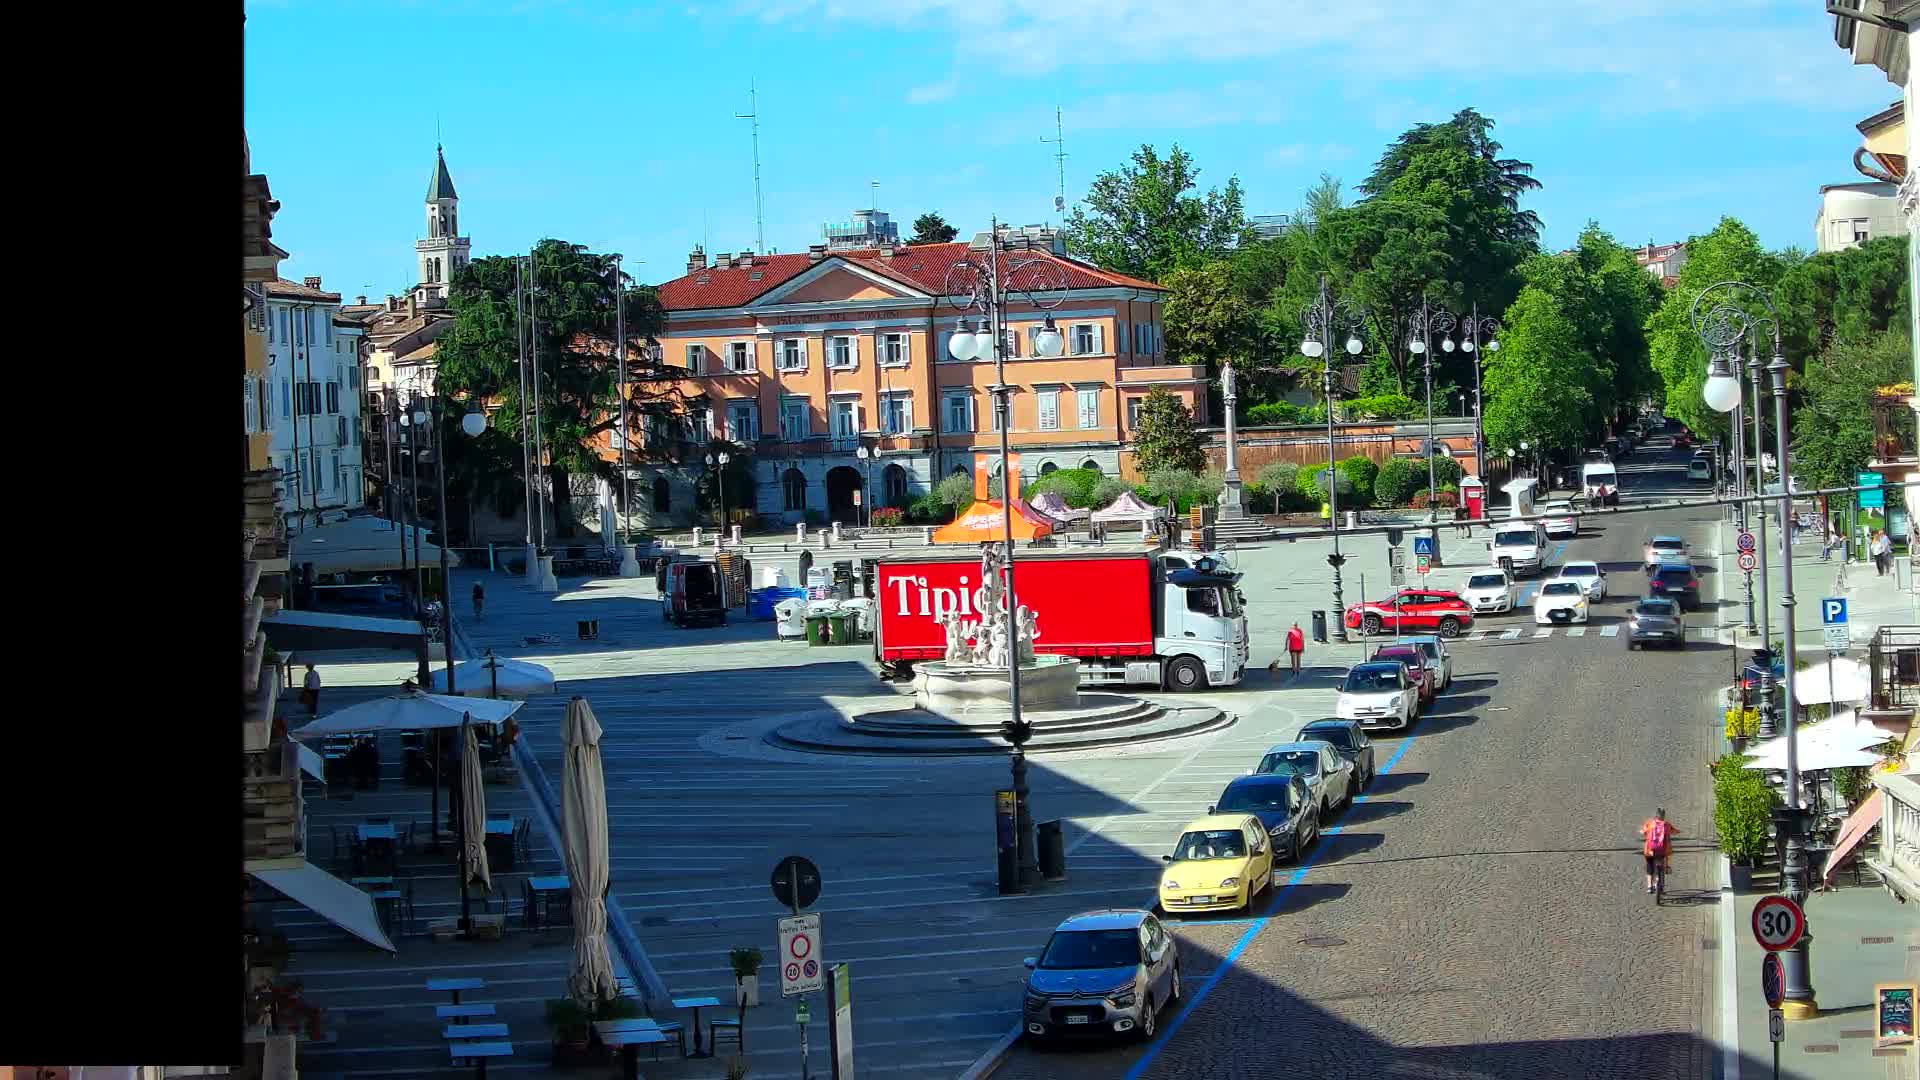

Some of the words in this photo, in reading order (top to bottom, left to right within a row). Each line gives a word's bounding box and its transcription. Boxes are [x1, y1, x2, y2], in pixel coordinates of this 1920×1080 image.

[1742, 557, 1753, 566] 20
[1827, 601, 1842, 621] P
[1761, 910, 1791, 937] 30
[788, 967, 797, 977] 20
